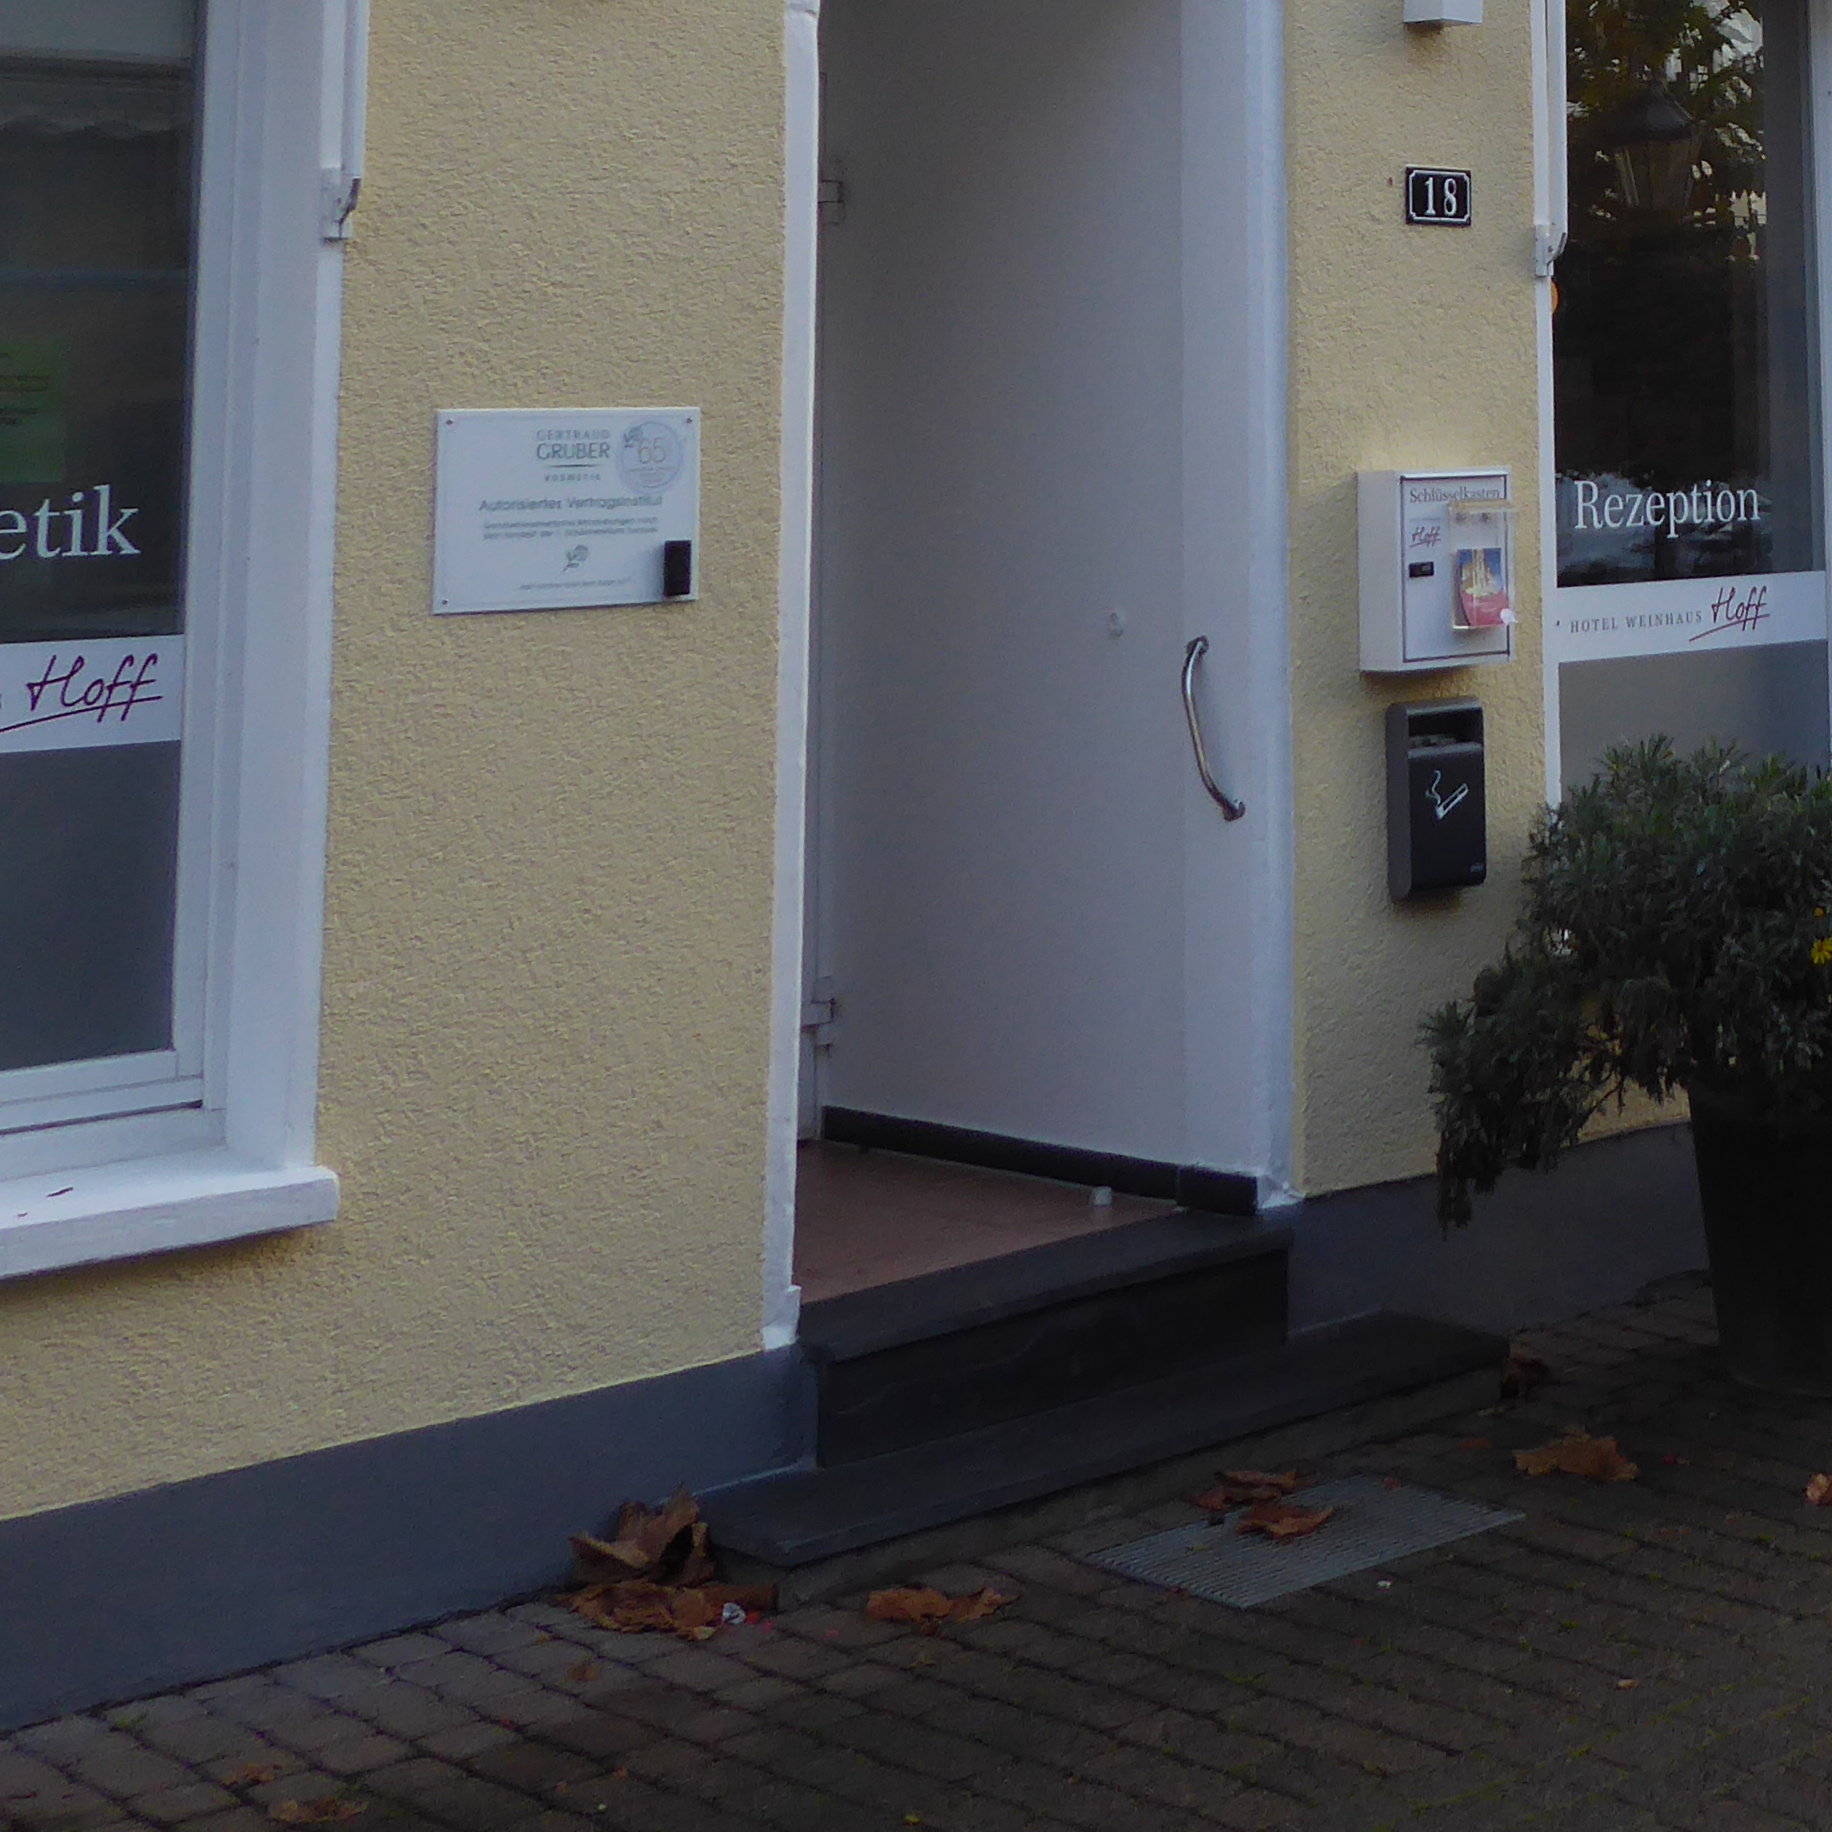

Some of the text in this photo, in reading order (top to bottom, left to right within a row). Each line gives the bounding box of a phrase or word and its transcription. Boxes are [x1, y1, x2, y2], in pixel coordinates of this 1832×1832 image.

[1424, 177, 1457, 216] 18
[536, 442, 611, 460] GRUBER
[1409, 486, 1500, 504] Schlüsselkasten
[1574, 479, 1761, 539] Rezeption
[1570, 585, 1768, 634] HOTEL WEINHAUS Hoff
[27, 654, 158, 723] Hoff
